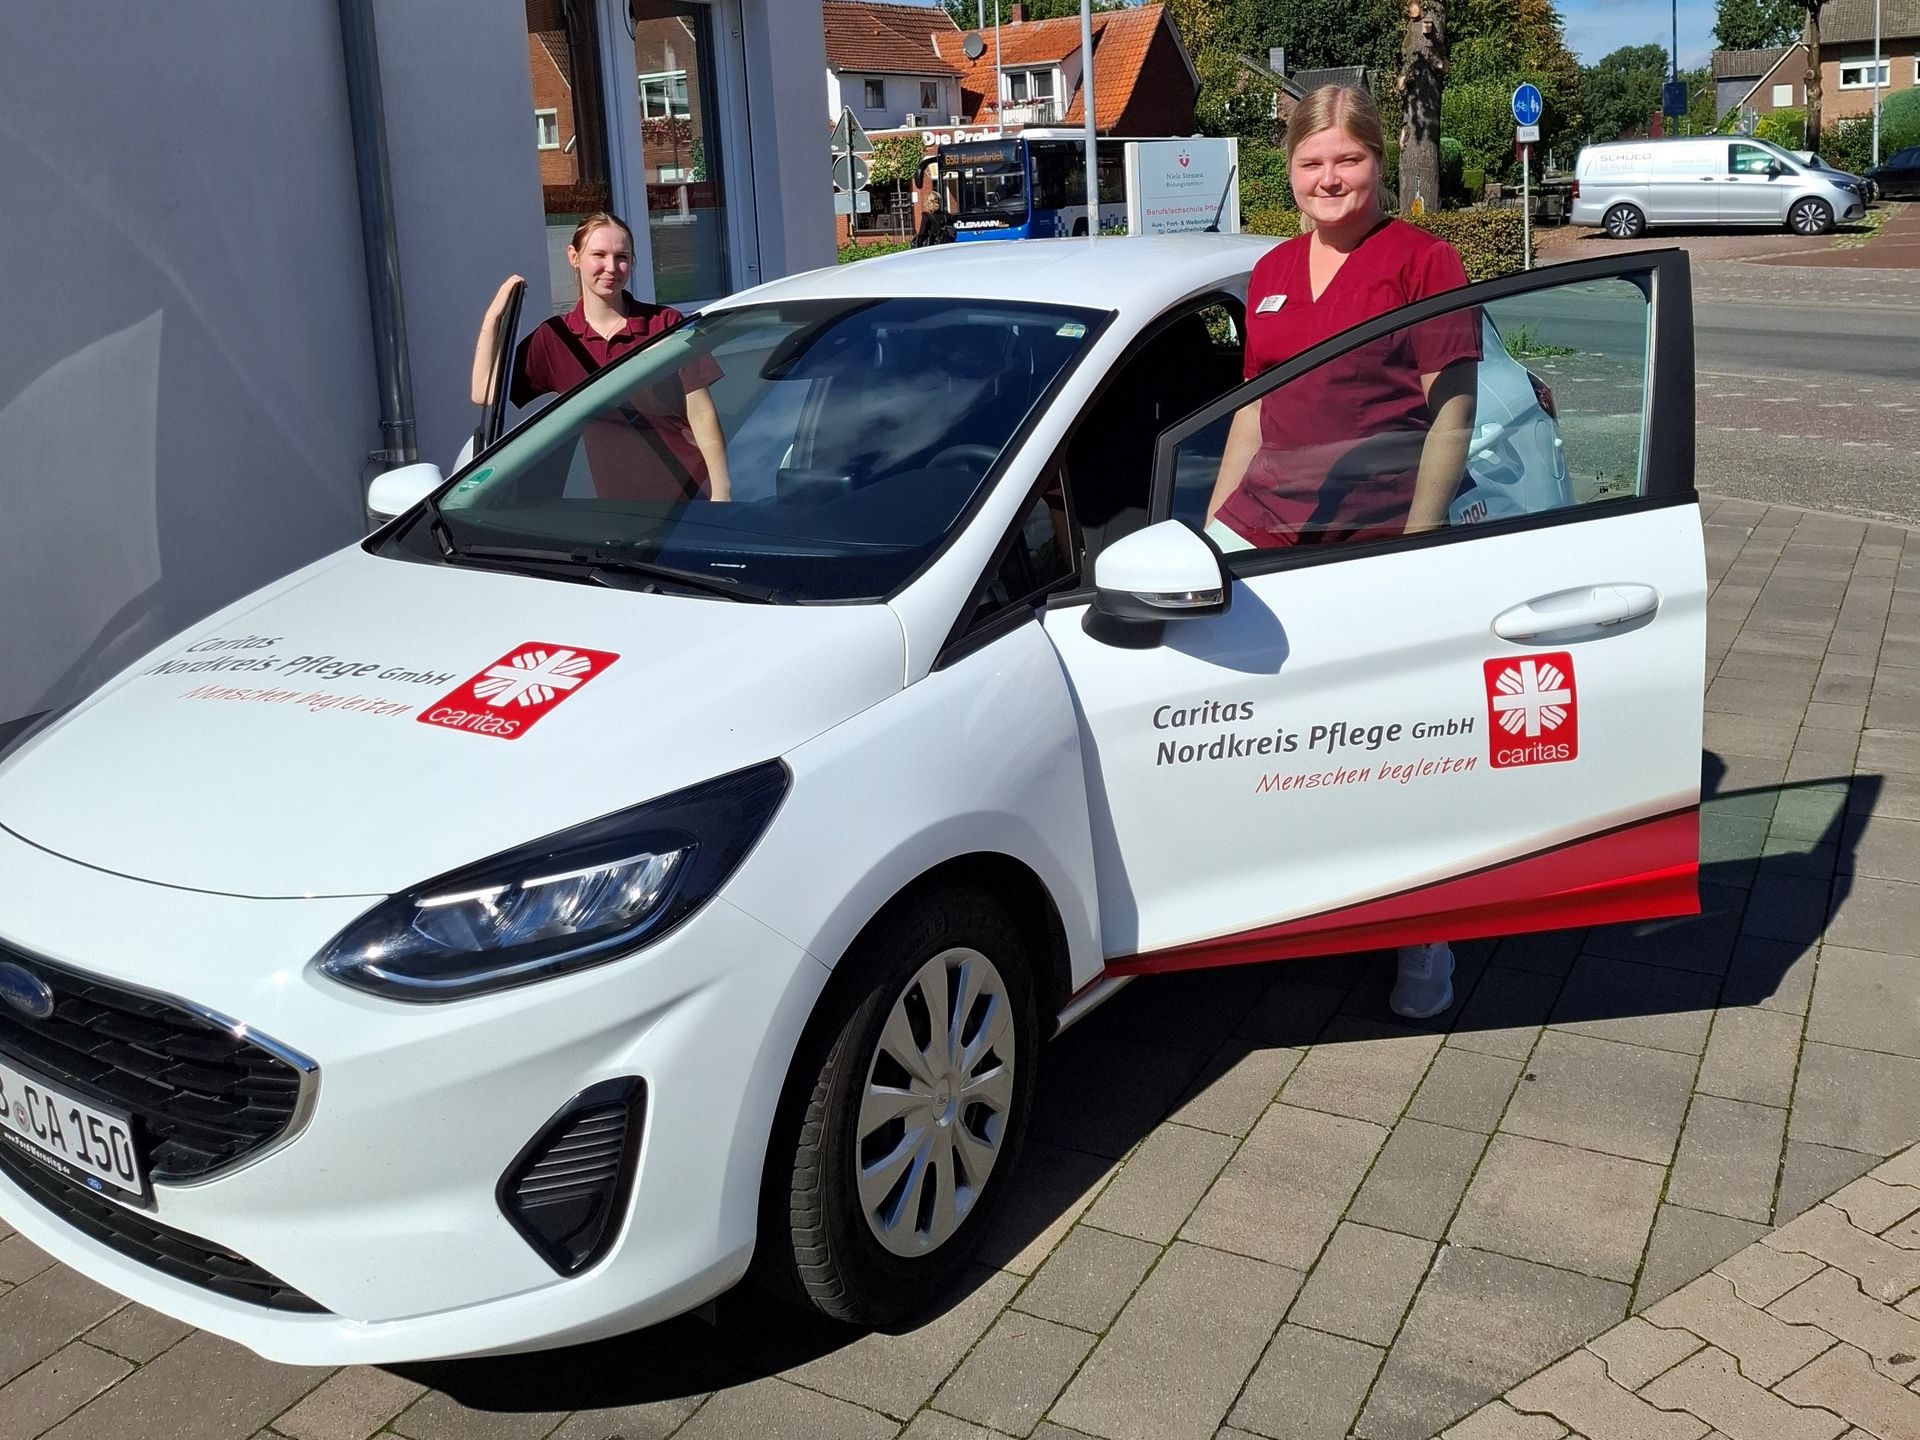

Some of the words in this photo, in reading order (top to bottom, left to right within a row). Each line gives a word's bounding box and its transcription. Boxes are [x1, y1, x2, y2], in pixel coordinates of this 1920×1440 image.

[922, 131, 951, 145] Die
[945, 154, 959, 165] 650
[1600, 151, 1652, 162] SCHÜCO
[1146, 205, 1204, 216] Berufsfachschule
[186, 635, 284, 653] Caritas
[143, 655, 282, 676] Nordkreis
[274, 656, 381, 680] Pflege
[377, 667, 457, 686] GmbH
[177, 685, 302, 704] Menschen
[294, 689, 414, 717] begleiten
[1153, 699, 1255, 730] Caritas
[428, 707, 521, 735] caritas
[1156, 728, 1299, 766] Nordkreis
[1308, 721, 1402, 755] Pflege
[1411, 717, 1475, 740] GmbH
[1497, 742, 1570, 766] caritas
[1255, 764, 1372, 794] Menschen
[1378, 755, 1478, 785] begleiten
[24, 1084, 68, 1153] CA
[69, 1108, 134, 1182] 150
